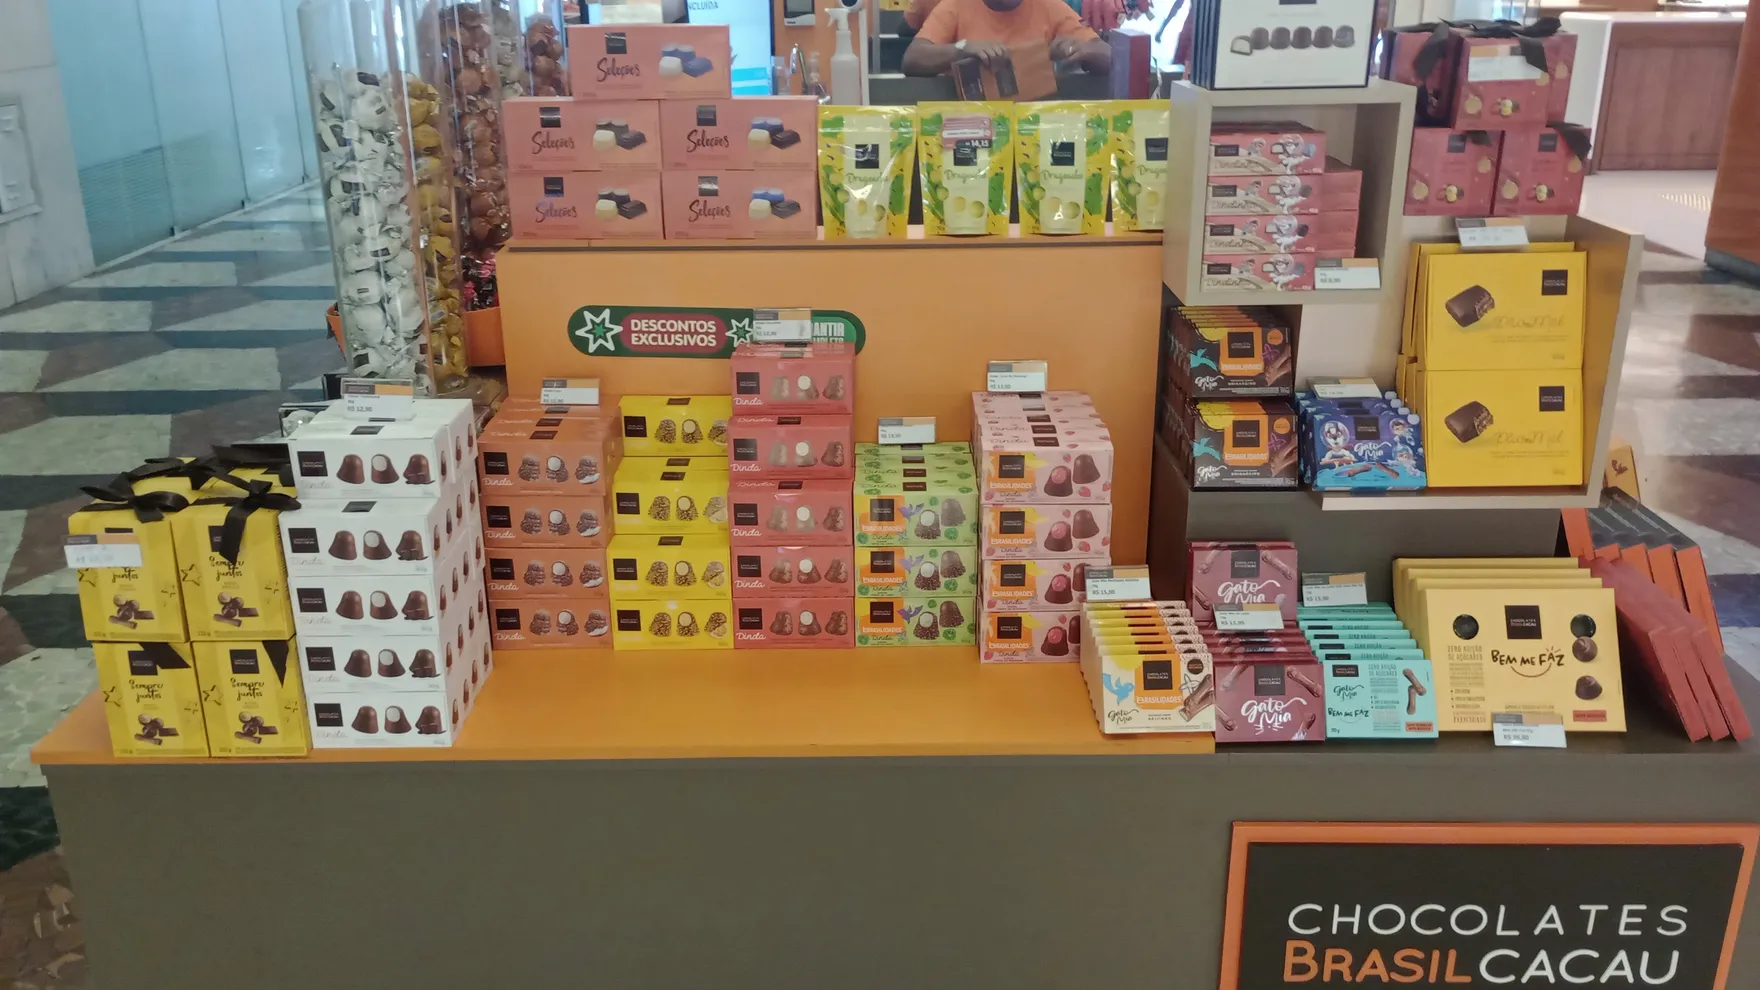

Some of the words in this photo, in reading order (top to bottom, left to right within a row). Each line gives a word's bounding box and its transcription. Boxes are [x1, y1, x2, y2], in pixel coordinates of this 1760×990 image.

[596, 57, 640, 83] Seleções
[532, 131, 575, 154] Seleções
[687, 131, 730, 154] Seleções
[535, 200, 577, 223] Seleções
[688, 200, 731, 223] Seleções
[630, 319, 716, 332] DESCONTOS
[631, 333, 717, 346] EXCLUSIVOS
[733, 397, 764, 406] Dinda
[730, 463, 762, 472] Dinda
[731, 528, 762, 537] Dinda
[216, 563, 243, 585] juntos
[734, 580, 765, 588] Dinda
[1235, 592, 1266, 604] Mia
[736, 632, 767, 640] Dinda
[1491, 649, 1516, 666] BEM
[1520, 656, 1535, 666] ME
[1539, 652, 1565, 666] FAZ
[135, 685, 162, 701] juntos
[236, 684, 263, 700] juntos
[1260, 711, 1292, 729] Mia
[1328, 708, 1343, 717] BEM
[1354, 709, 1369, 718] FAZ
[1287, 903, 1688, 936] CHOCOLATES
[1283, 940, 1472, 983] BRASIL
[1479, 949, 1679, 983] CACAU
